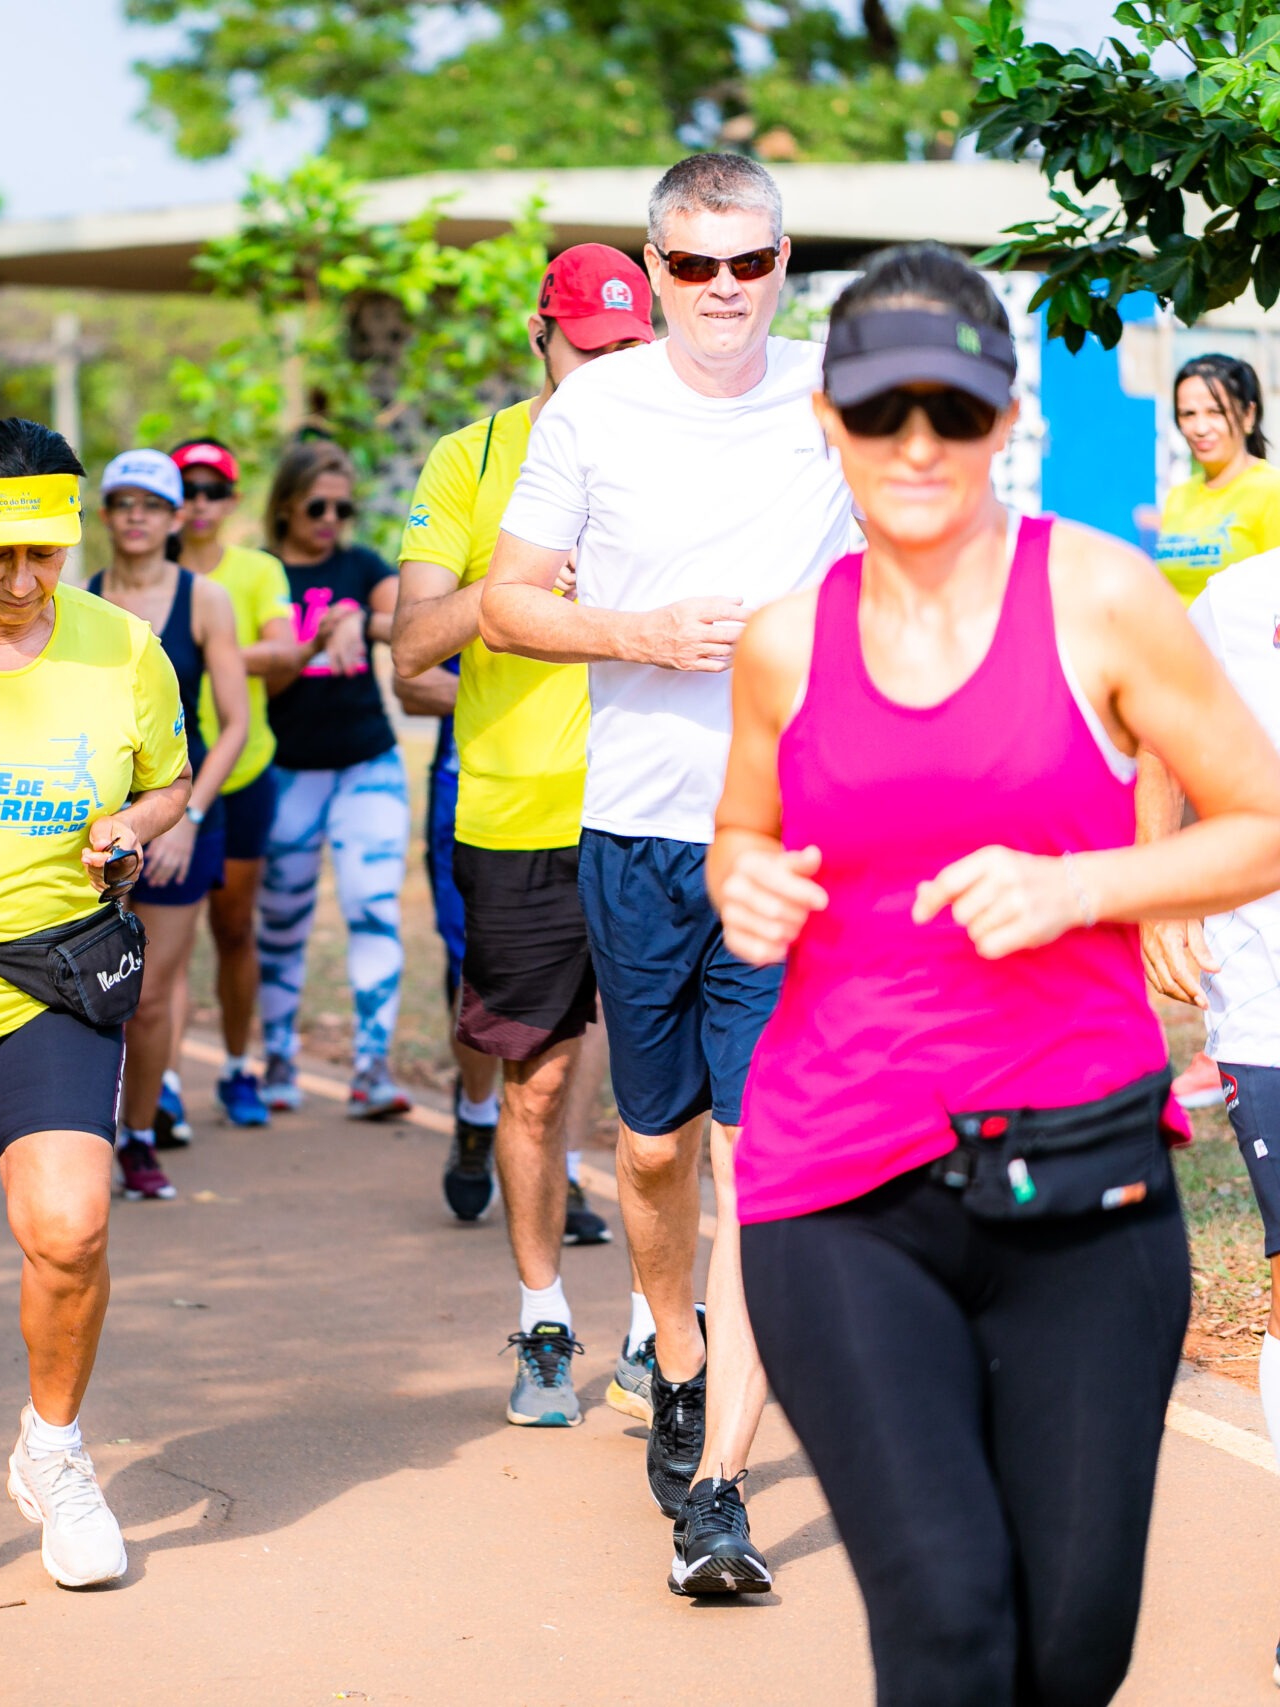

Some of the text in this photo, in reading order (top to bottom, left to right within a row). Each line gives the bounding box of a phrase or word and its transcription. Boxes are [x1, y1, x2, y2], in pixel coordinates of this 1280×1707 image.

[20, 497, 41, 505] Brasil
[15, 780, 44, 797] DE
[29, 822, 87, 836] SESC-DF
